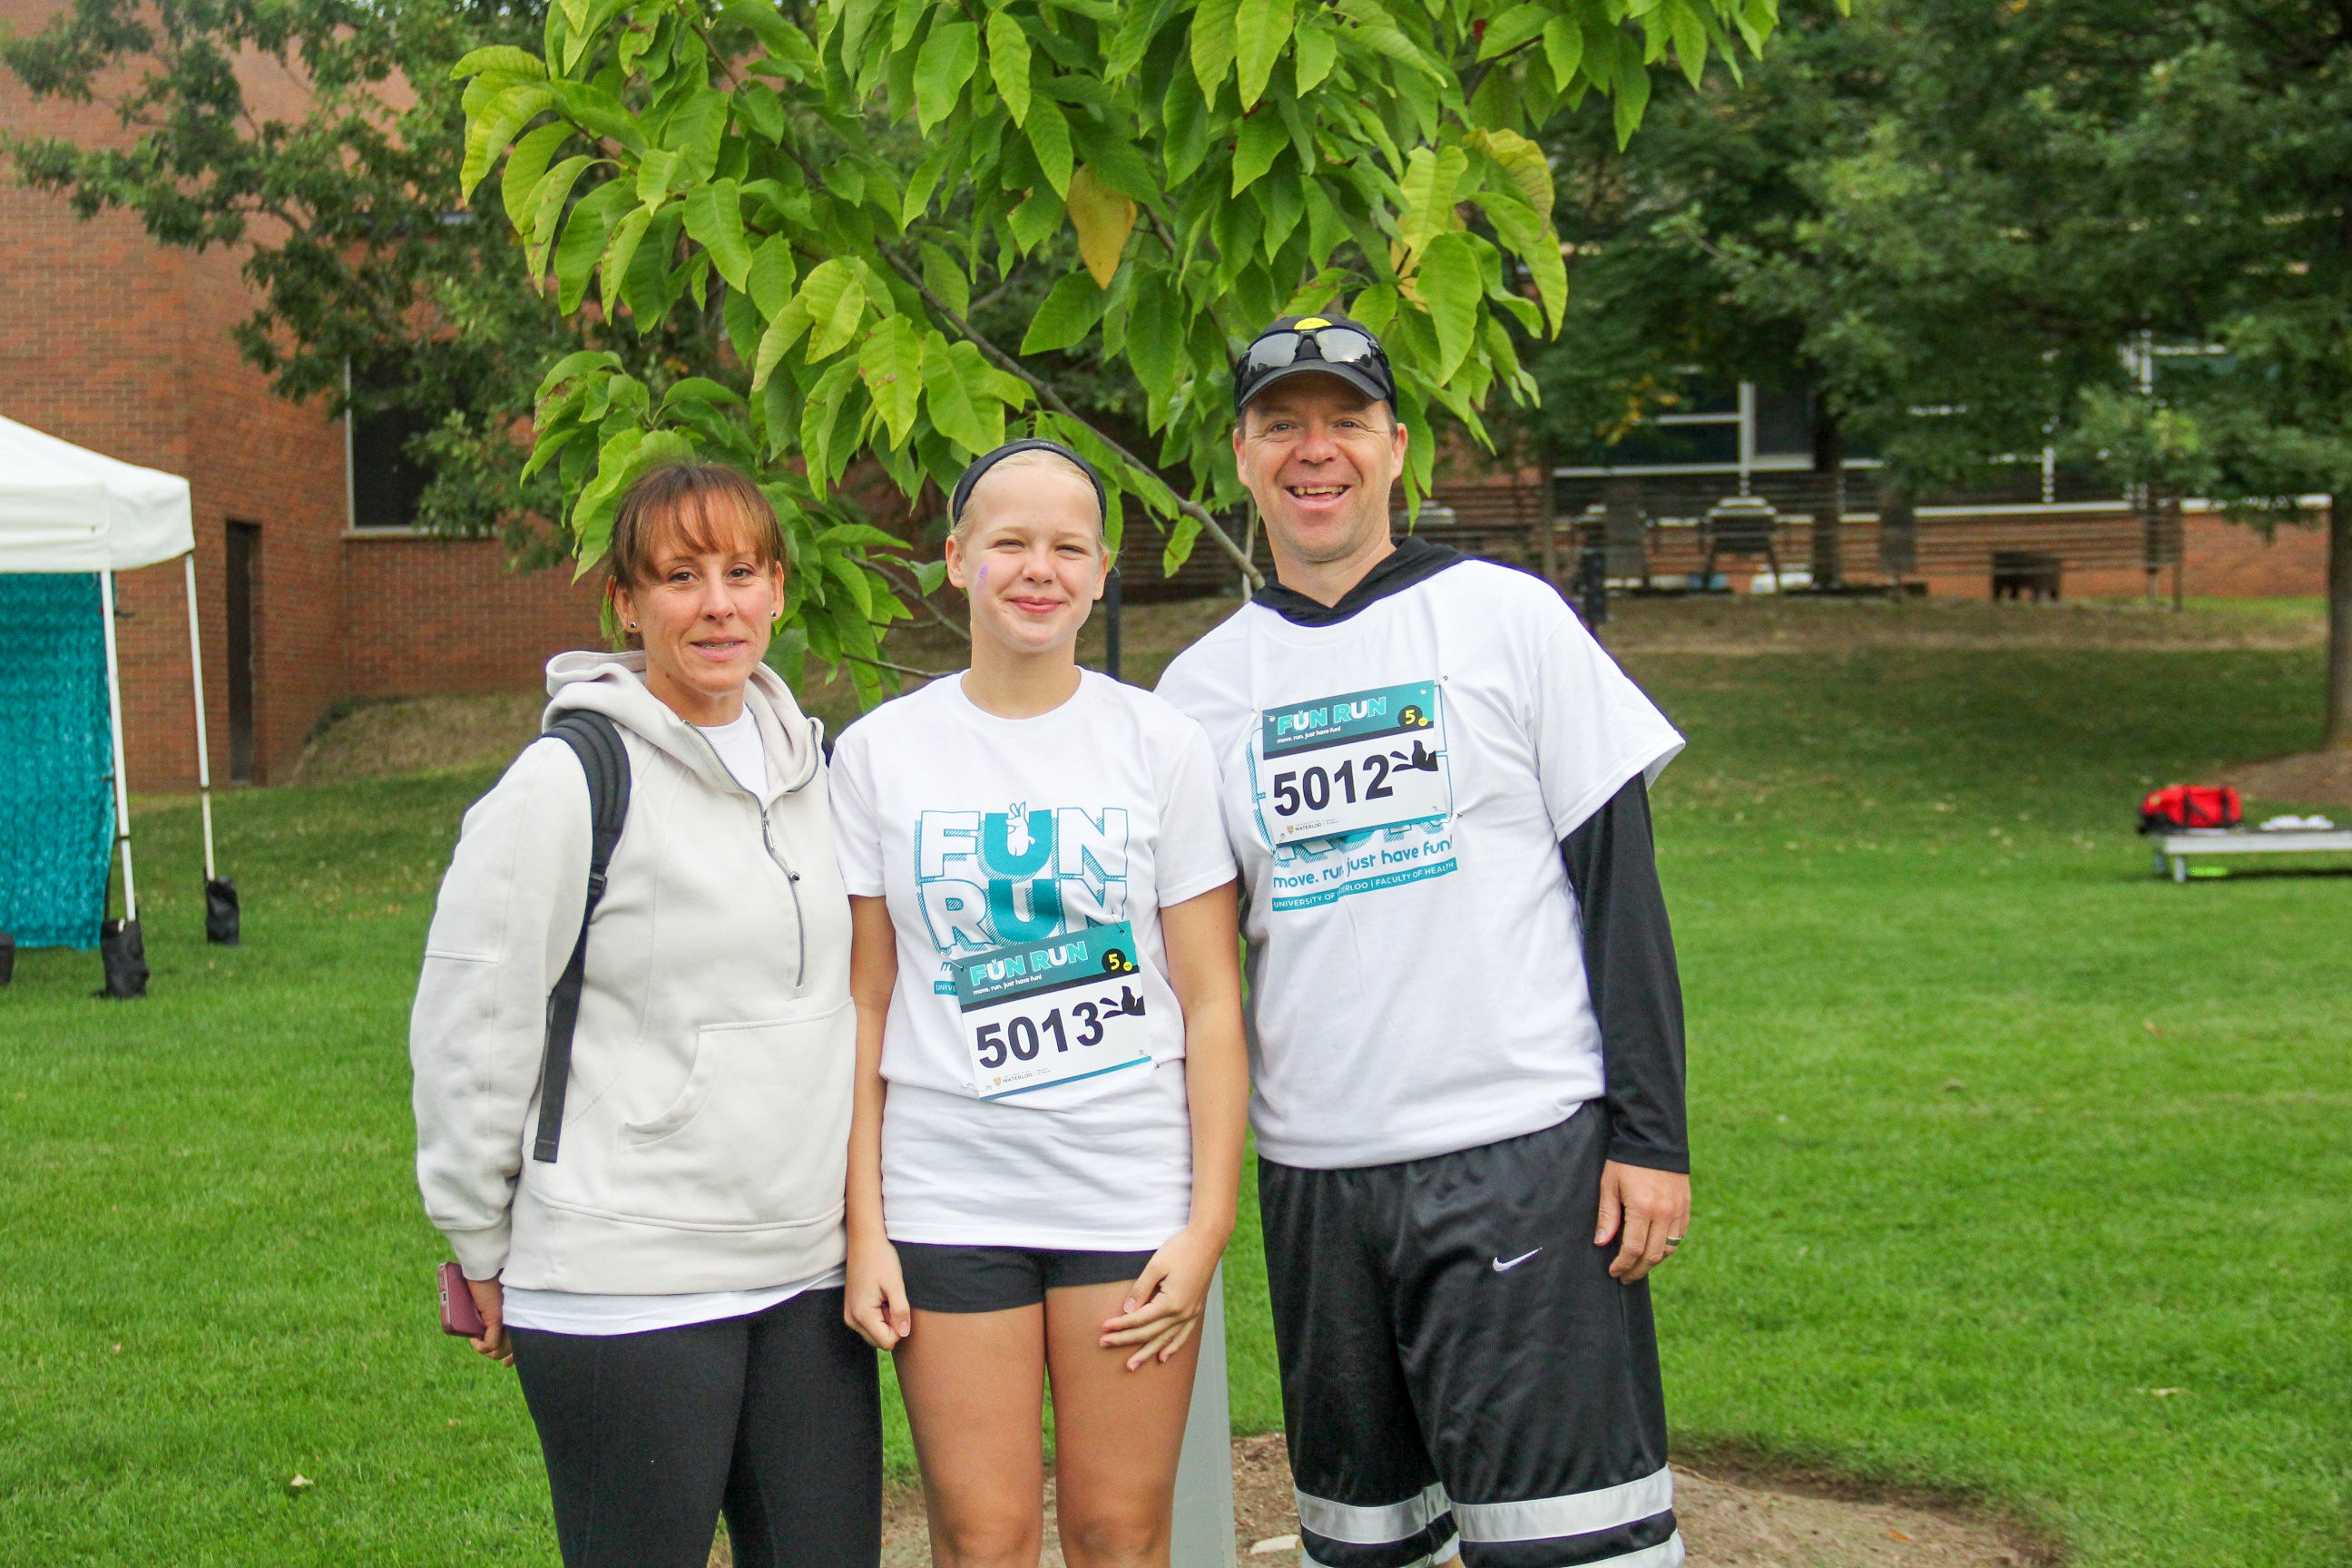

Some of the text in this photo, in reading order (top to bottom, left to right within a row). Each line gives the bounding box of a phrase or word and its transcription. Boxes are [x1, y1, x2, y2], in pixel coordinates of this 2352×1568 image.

[1278, 697, 1387, 735] FUN RUN
[1305, 731, 1315, 740] just
[1405, 709, 1416, 725] 5
[1274, 754, 1393, 816] 5012
[919, 807, 1128, 878] FUN
[1295, 823, 1322, 831] WATERLOO
[1273, 873, 1318, 888] move.
[1347, 854, 1376, 877] just
[1381, 848, 1419, 865] have
[1423, 834, 1453, 857] fun!
[1273, 896, 1322, 908] UNIVERSITY
[1324, 892, 1336, 901] OF
[1376, 873, 1411, 887] FACULTY
[1412, 869, 1422, 877] OF
[1425, 862, 1454, 876] HEALTH
[921, 877, 1128, 947] RUN
[969, 941, 1088, 985] FUN RUN
[1108, 953, 1120, 971] 5
[1004, 981, 1014, 989] just
[975, 1002, 1103, 1069] 5013
